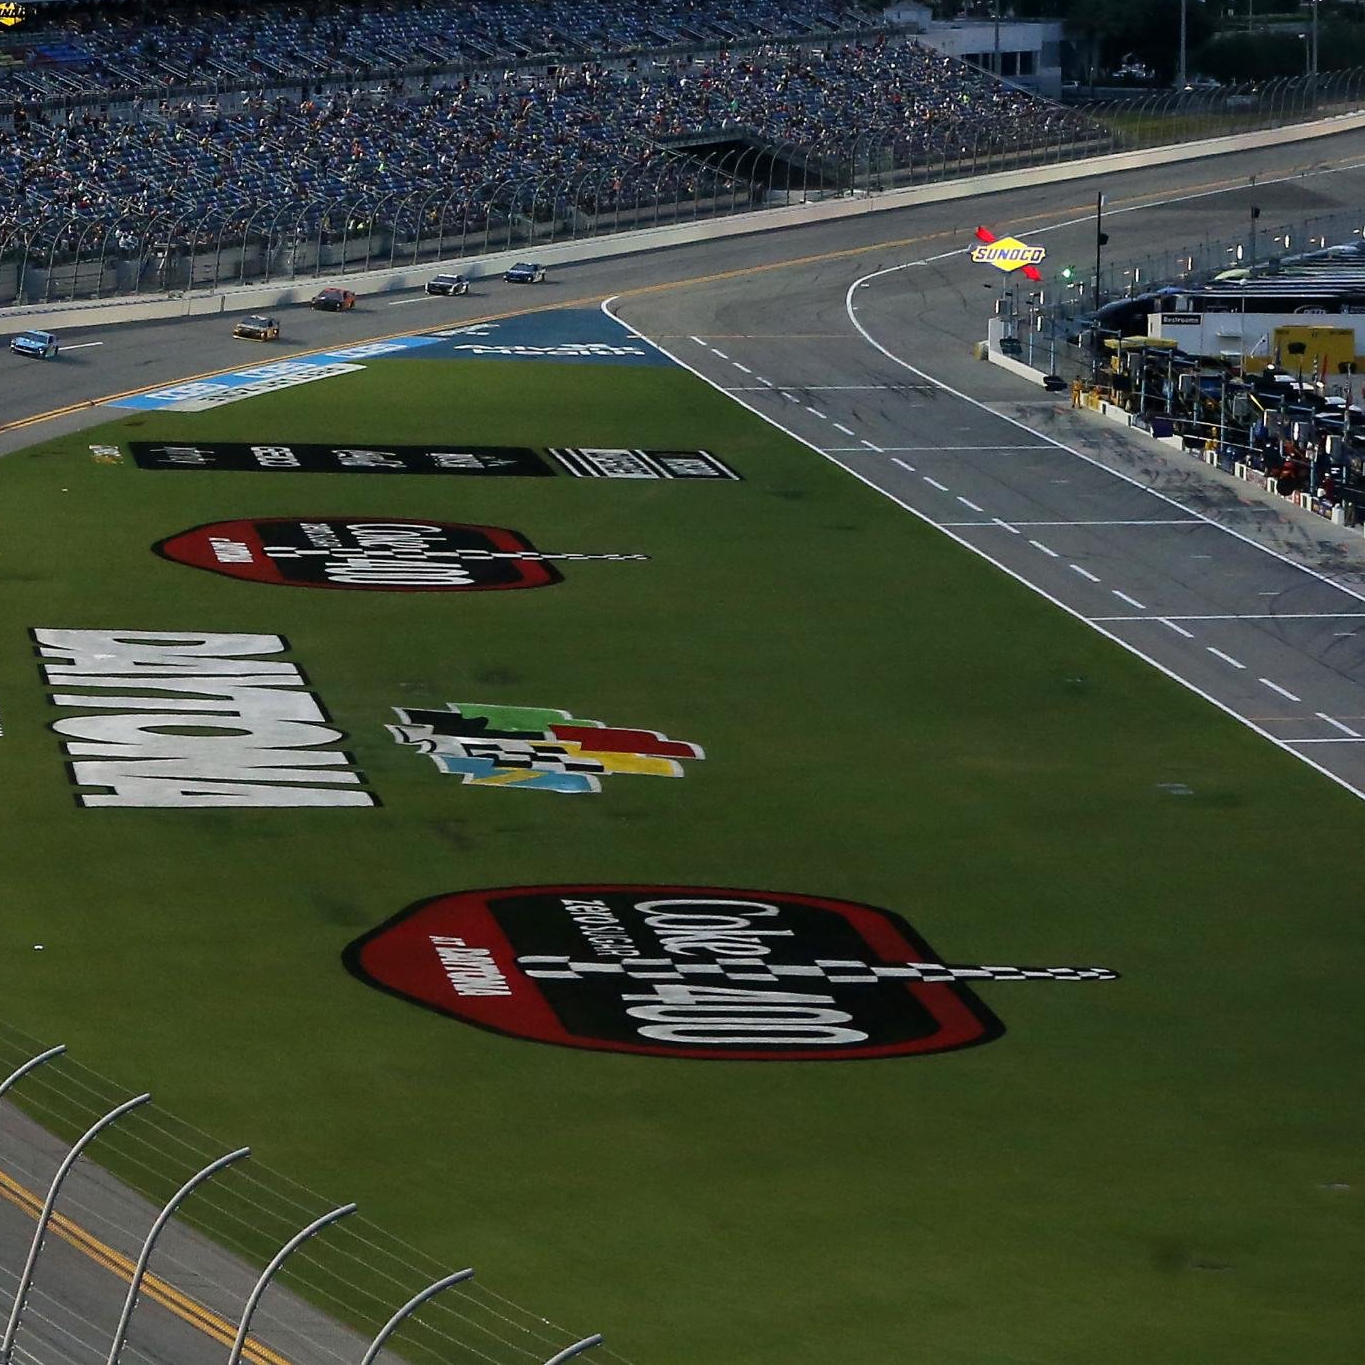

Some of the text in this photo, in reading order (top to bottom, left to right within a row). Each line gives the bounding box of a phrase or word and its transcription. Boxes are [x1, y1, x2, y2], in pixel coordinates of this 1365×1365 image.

[975, 248, 1043, 261] SUNOCO
[1163, 316, 1199, 324] Restrooms
[346, 523, 447, 549] Coke
[325, 558, 476, 585] 400
[33, 627, 375, 808] DAYTONA
[560, 899, 642, 957] zero SUGAR
[428, 935, 513, 996] AT DAYTONA
[622, 898, 869, 1044] Coke 400
